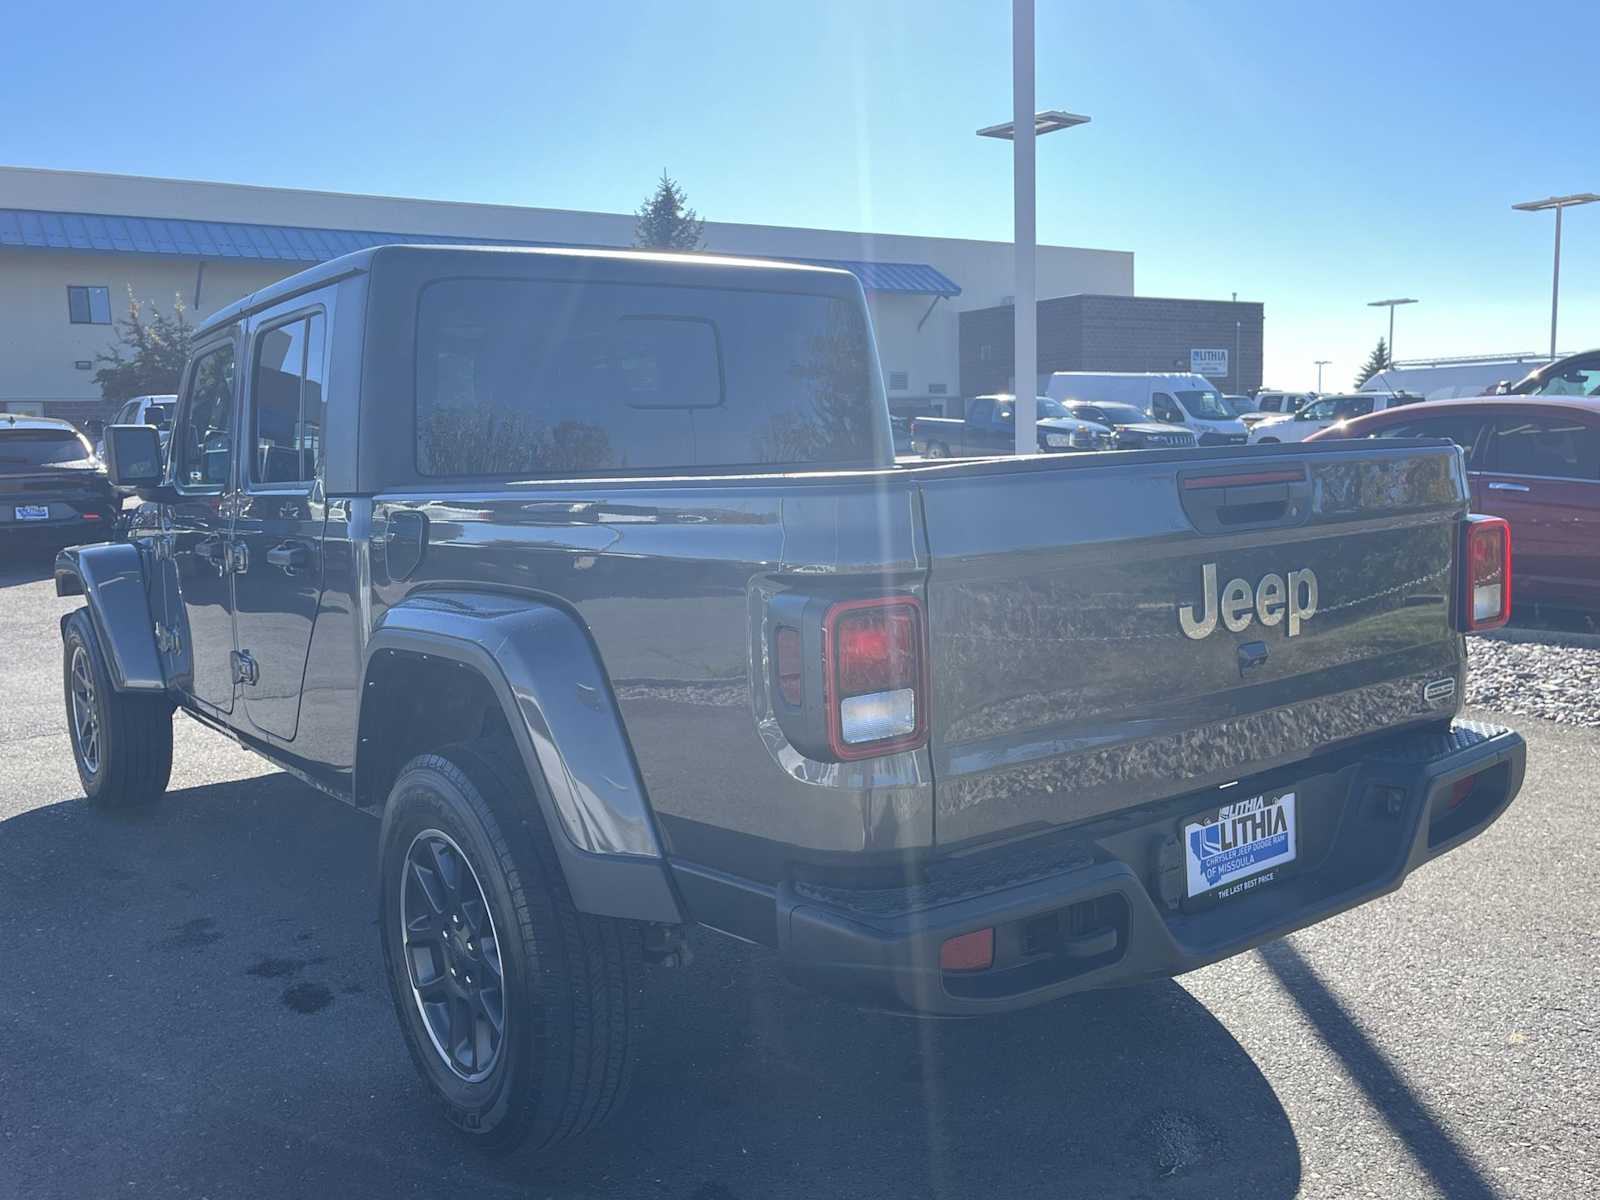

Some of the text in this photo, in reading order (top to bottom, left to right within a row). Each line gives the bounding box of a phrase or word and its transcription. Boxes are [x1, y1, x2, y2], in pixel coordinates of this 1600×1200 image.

[1200, 351, 1226, 361] LITHIA
[1179, 563, 1319, 640] Jeep
[1229, 795, 1264, 818] LITHIA
[1221, 805, 1288, 851] LITHIA
[1206, 834, 1286, 867] CHRYSLER JEEP DODGE RAM
[1206, 854, 1255, 879] OF MISSOULA
[1218, 872, 1274, 899] THE LAST BEST PRICE
